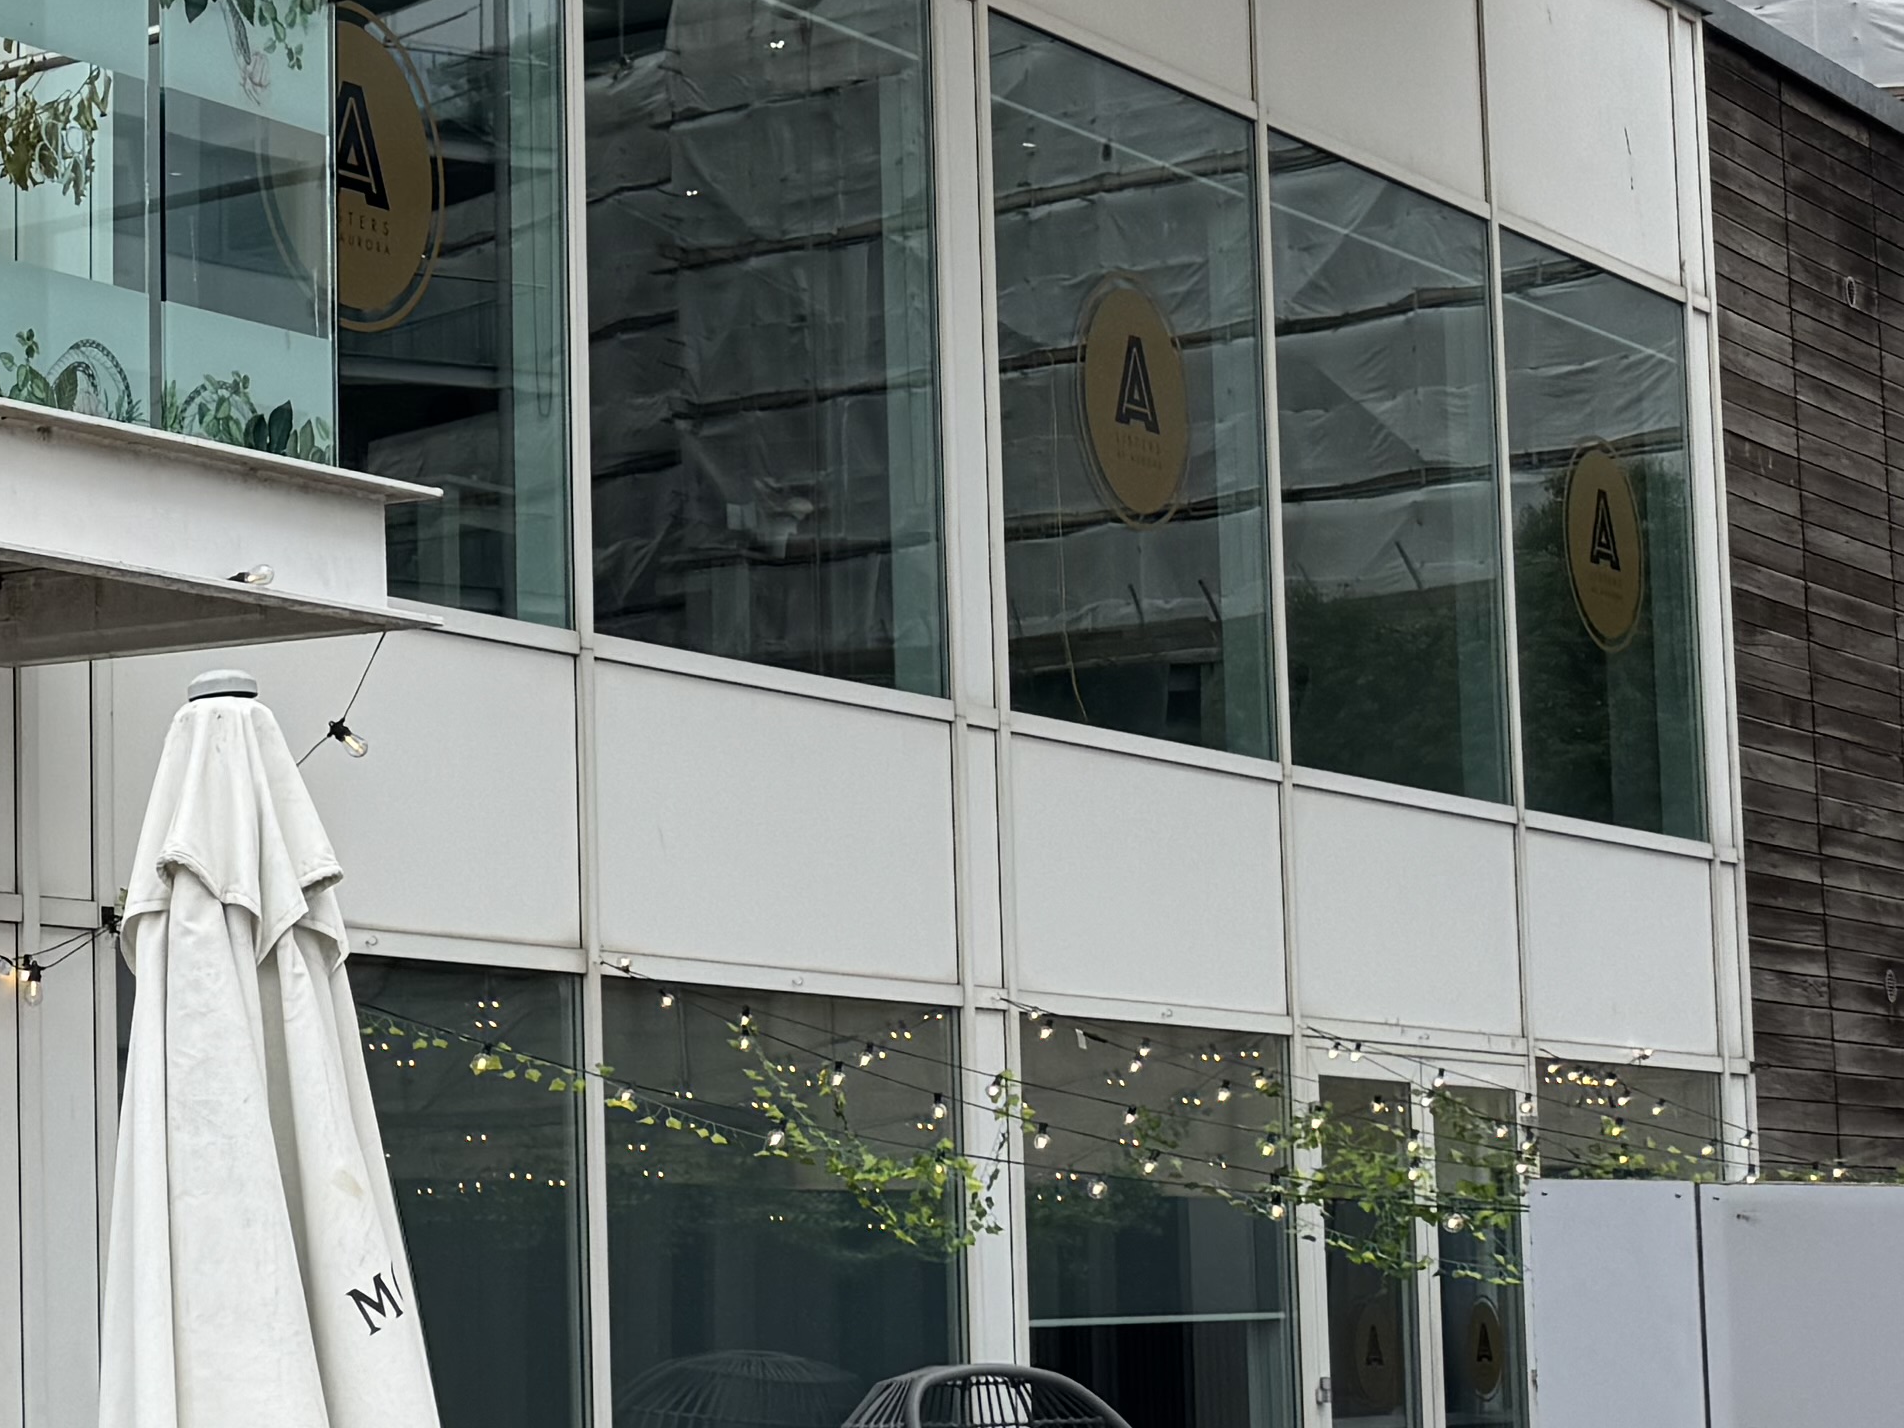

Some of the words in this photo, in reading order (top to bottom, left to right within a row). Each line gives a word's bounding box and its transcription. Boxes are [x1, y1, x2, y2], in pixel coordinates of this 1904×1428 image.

[1115, 334, 1161, 435] A
[1590, 488, 1622, 572] A
[345, 1260, 403, 1336] M
